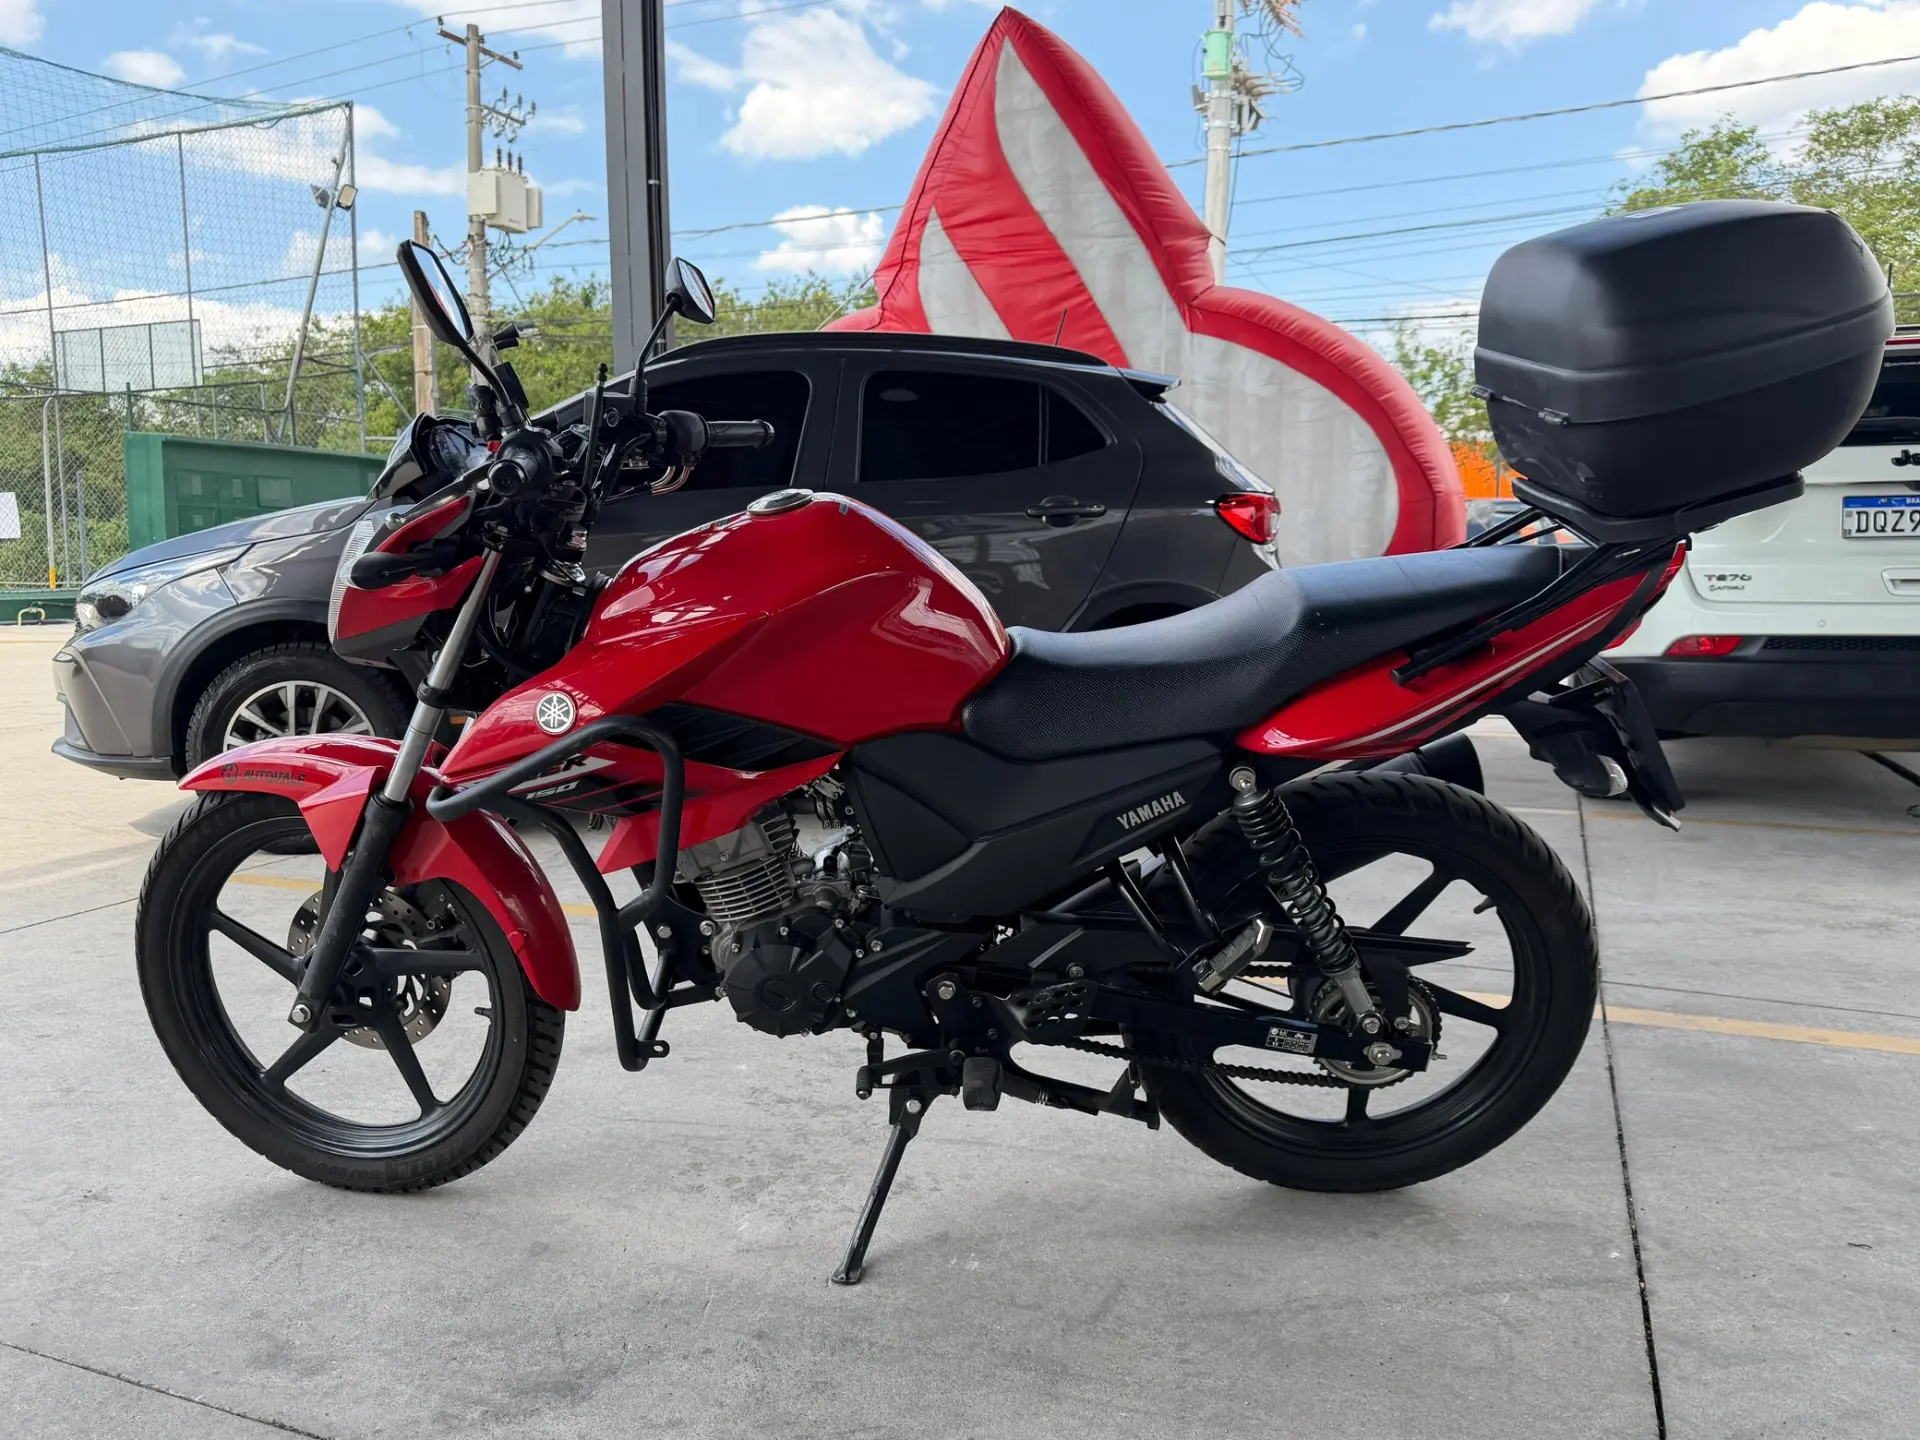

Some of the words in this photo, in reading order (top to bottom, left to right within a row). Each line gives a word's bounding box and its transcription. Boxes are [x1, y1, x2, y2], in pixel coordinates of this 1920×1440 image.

[1856, 510, 1920, 533] DQZ9
[526, 780, 580, 800] 150
[1117, 791, 1186, 830] YAMAHA
